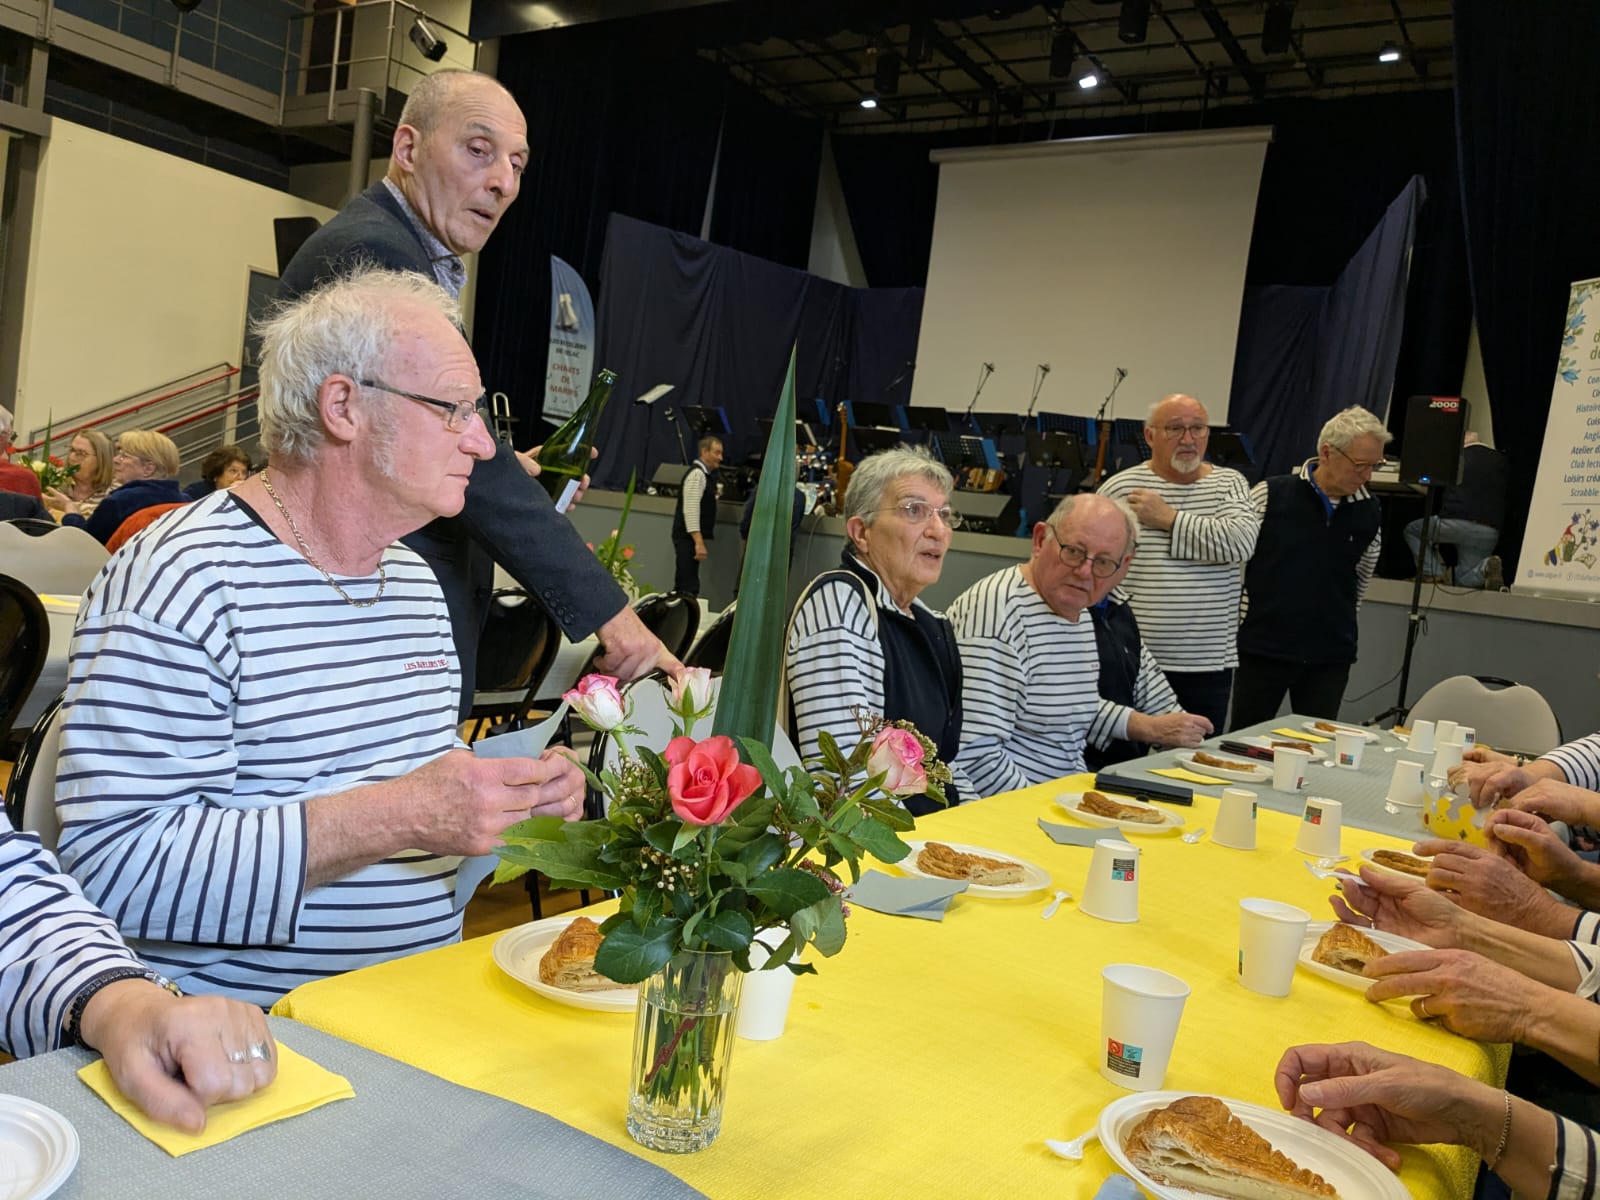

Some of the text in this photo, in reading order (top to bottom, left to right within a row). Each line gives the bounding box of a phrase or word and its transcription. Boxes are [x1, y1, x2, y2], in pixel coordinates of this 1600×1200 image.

[1571, 445, 1593, 455] Atelier
[1570, 460, 1585, 469] Club
[1564, 473, 1584, 483] Loisirs
[1570, 487, 1599, 497] Scrabble
